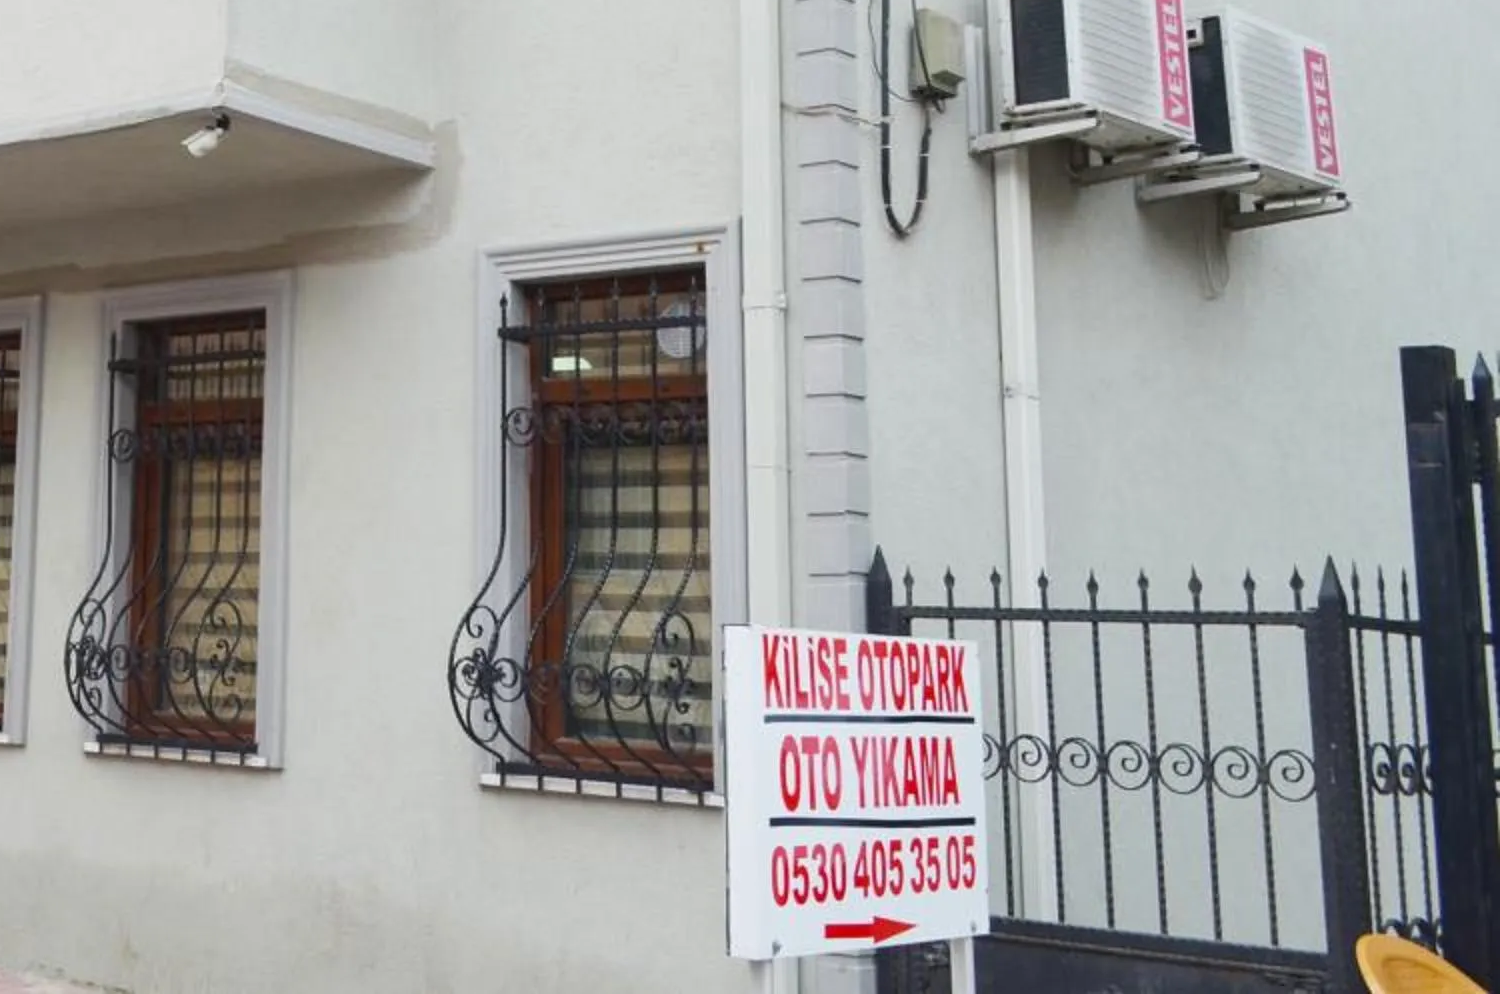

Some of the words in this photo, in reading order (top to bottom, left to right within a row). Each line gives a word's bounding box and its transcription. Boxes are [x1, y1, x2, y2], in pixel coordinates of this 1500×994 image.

[1309, 57, 1334, 169] VESTEL
[857, 639, 969, 712] OTOPARK
[780, 734, 842, 812] OTO
[850, 736, 960, 808] YIKAMA
[771, 842, 847, 906] 0530
[853, 839, 902, 897] 405
[910, 837, 940, 894] 35
[947, 835, 977, 889] 05
